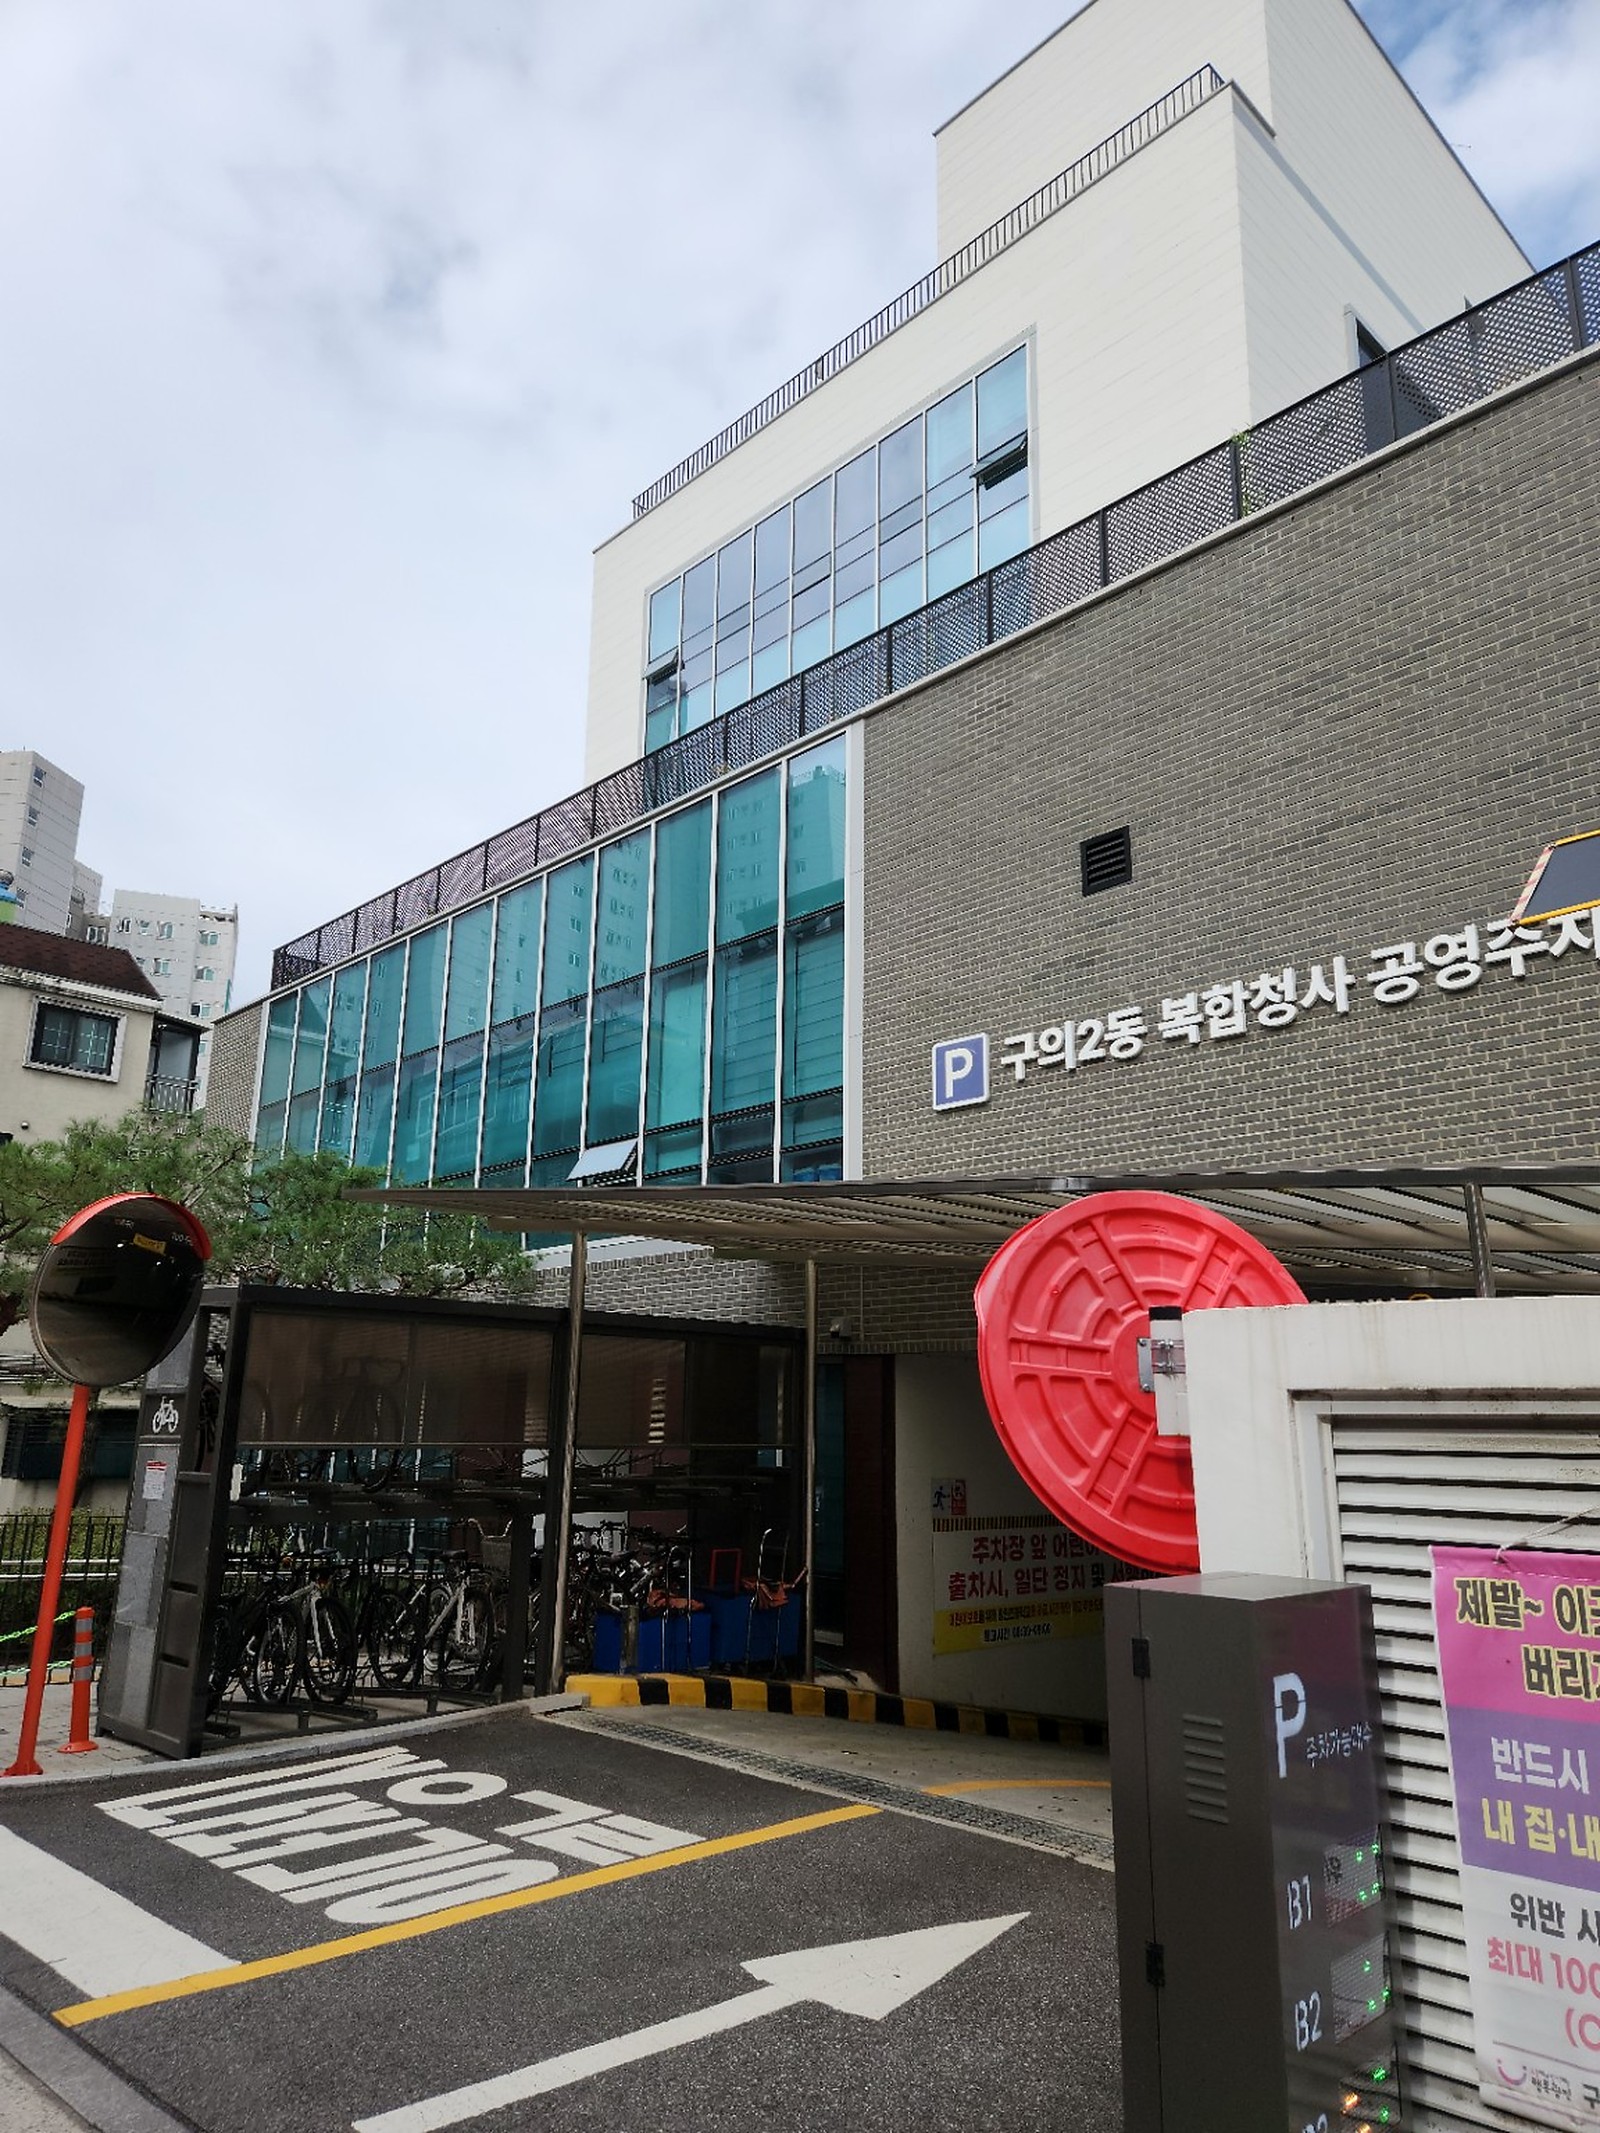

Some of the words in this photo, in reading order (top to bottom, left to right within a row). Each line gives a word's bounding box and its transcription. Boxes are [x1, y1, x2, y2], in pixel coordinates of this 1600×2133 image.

[944, 1047, 974, 1099] P
[1000, 1005, 1148, 1082] 구의2동
[1158, 954, 1356, 1044] 복합청사
[972, 1534, 1025, 1565] 주차장
[1030, 1534, 1047, 1561] 앞
[1014, 1566, 1048, 1595] 일단
[1052, 1564, 1086, 1591] 정지
[1454, 1577, 1544, 1630] 제발~
[1273, 1672, 1307, 1779] P
[1306, 1721, 1373, 1769] 주차가능대수
[1491, 1737, 1590, 1795] 반드시
[1481, 1798, 1516, 1845] 내
[1287, 1874, 1312, 1930] B1
[1510, 1893, 1566, 1939] 위반
[1488, 1936, 1543, 1984] 최대
[1295, 1991, 1323, 2052] B2
